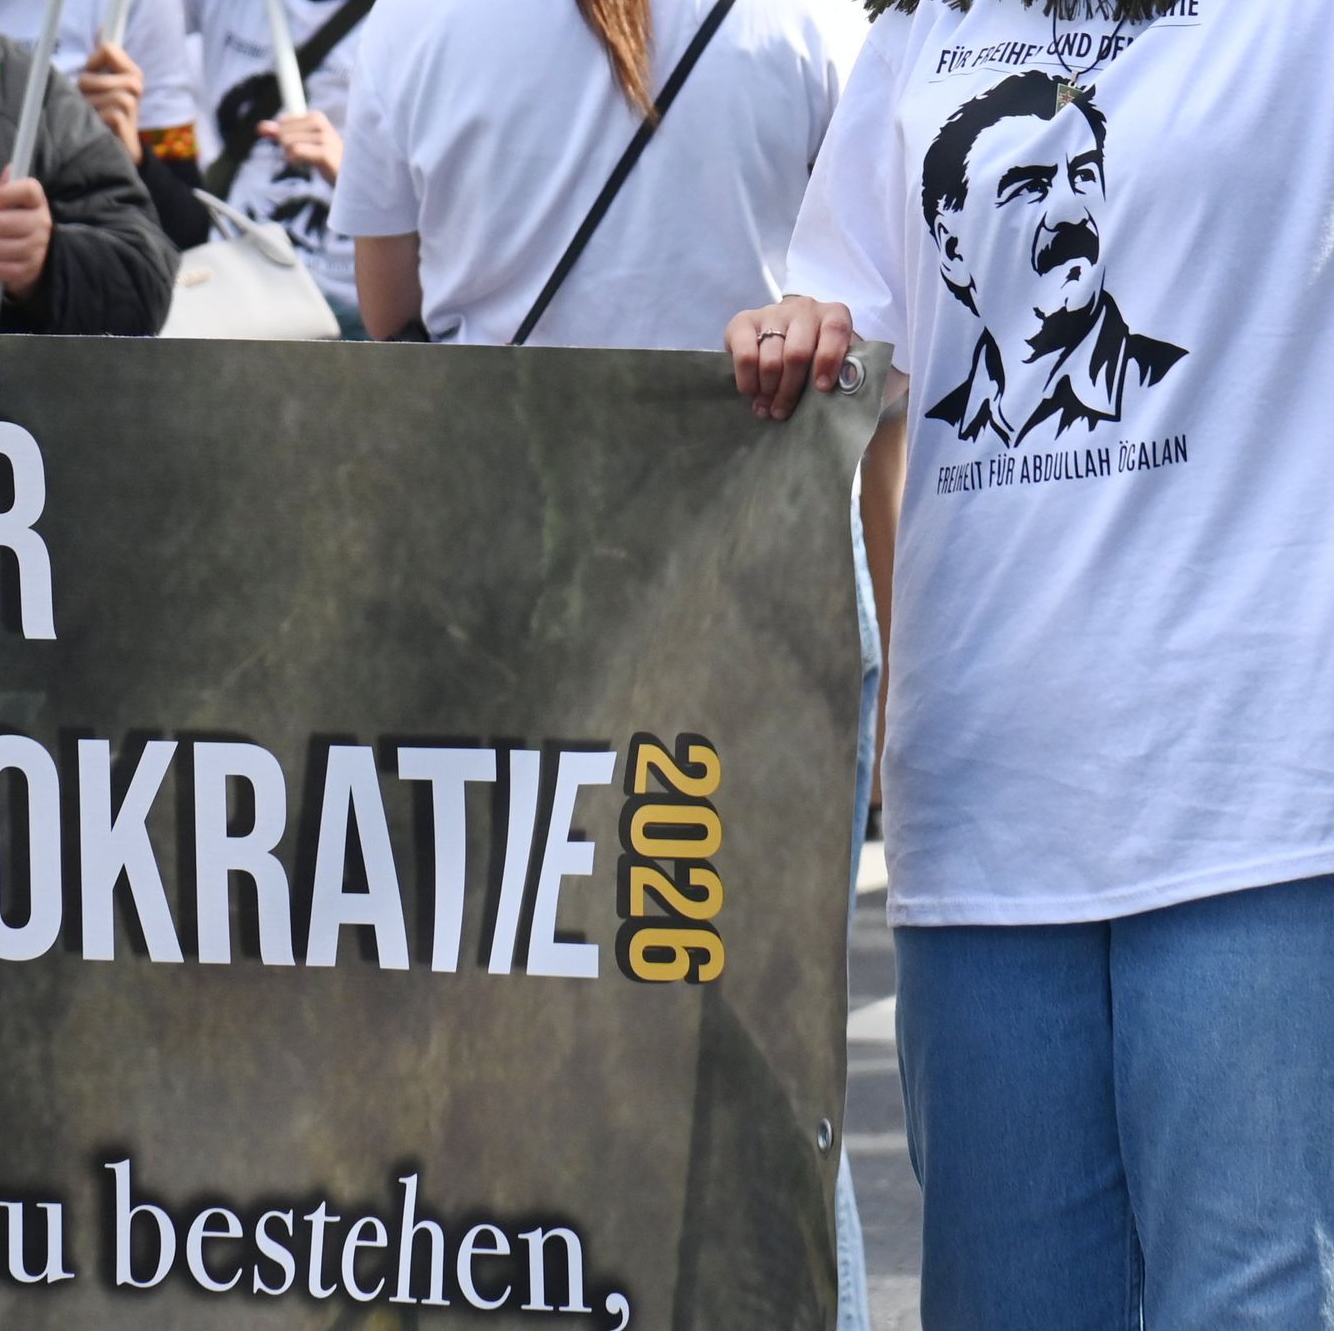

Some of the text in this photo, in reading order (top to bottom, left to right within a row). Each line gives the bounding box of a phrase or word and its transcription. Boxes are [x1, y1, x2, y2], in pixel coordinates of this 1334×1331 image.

[936, 46, 972, 74] FÜR
[937, 433, 1188, 496] FREIHEIT FÜR ABDULLAH ÖCALAN
[627, 742, 725, 984] 2026
[102, 1157, 630, 1331] bestehen,
